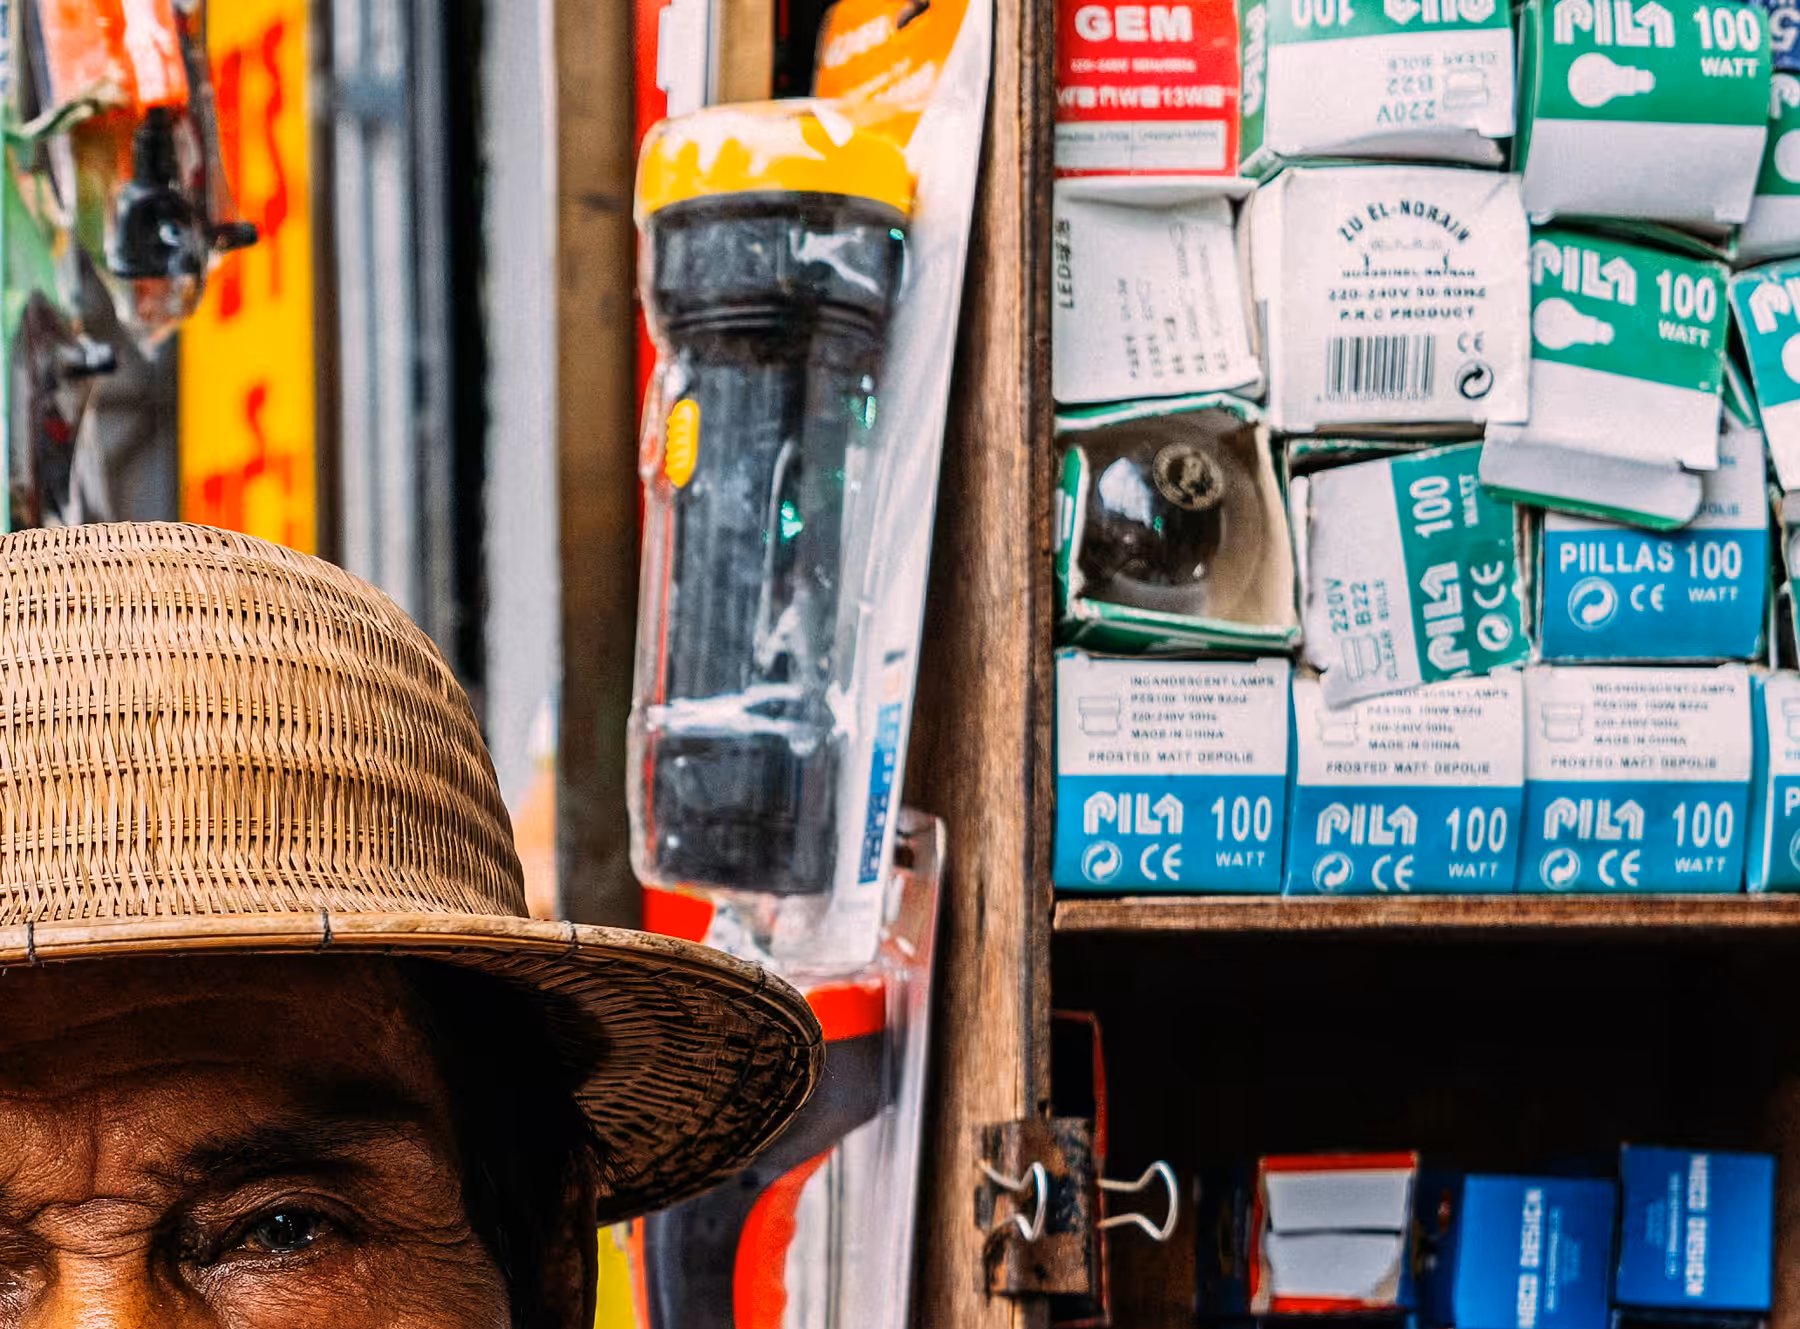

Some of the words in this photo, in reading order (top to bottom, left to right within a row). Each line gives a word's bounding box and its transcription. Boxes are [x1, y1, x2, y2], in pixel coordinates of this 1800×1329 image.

[1075, 5, 1192, 42] GEM
[1553, 0, 1675, 48] PILA
[1694, 9, 1761, 52] 100
[1701, 57, 1759, 78] WATT
[1386, 75, 1433, 95] B22
[1376, 99, 1436, 123] 220V
[1390, 305, 1475, 320] PRODUCT
[1656, 269, 1717, 323] 100
[1658, 318, 1711, 348] WATT
[1409, 475, 1455, 539] 100
[1457, 472, 1480, 529] WATT
[1560, 542, 1675, 573] PIILLAS
[1685, 541, 1742, 580] 100
[1323, 577, 1350, 634] 220V
[1350, 581, 1372, 626] B22
[1688, 586, 1739, 603] WATT
[1418, 561, 1471, 672] PILA
[1131, 730, 1167, 740] MADE
[1169, 730, 1183, 740] IN
[1088, 751, 1151, 764] FROSTED
[1156, 751, 1193, 764] MATT
[1326, 761, 1387, 774] FROSTED
[1393, 761, 1427, 774] MATT
[1083, 790, 1185, 836] PILA
[1211, 795, 1273, 842] 100
[1315, 802, 1419, 846] PILA
[1445, 806, 1508, 853] 100
[1543, 797, 1645, 841] PILA
[1672, 800, 1734, 849] 100
[1215, 850, 1266, 868] WATT
[1448, 861, 1499, 879] WATT
[1675, 856, 1726, 873] WATT
